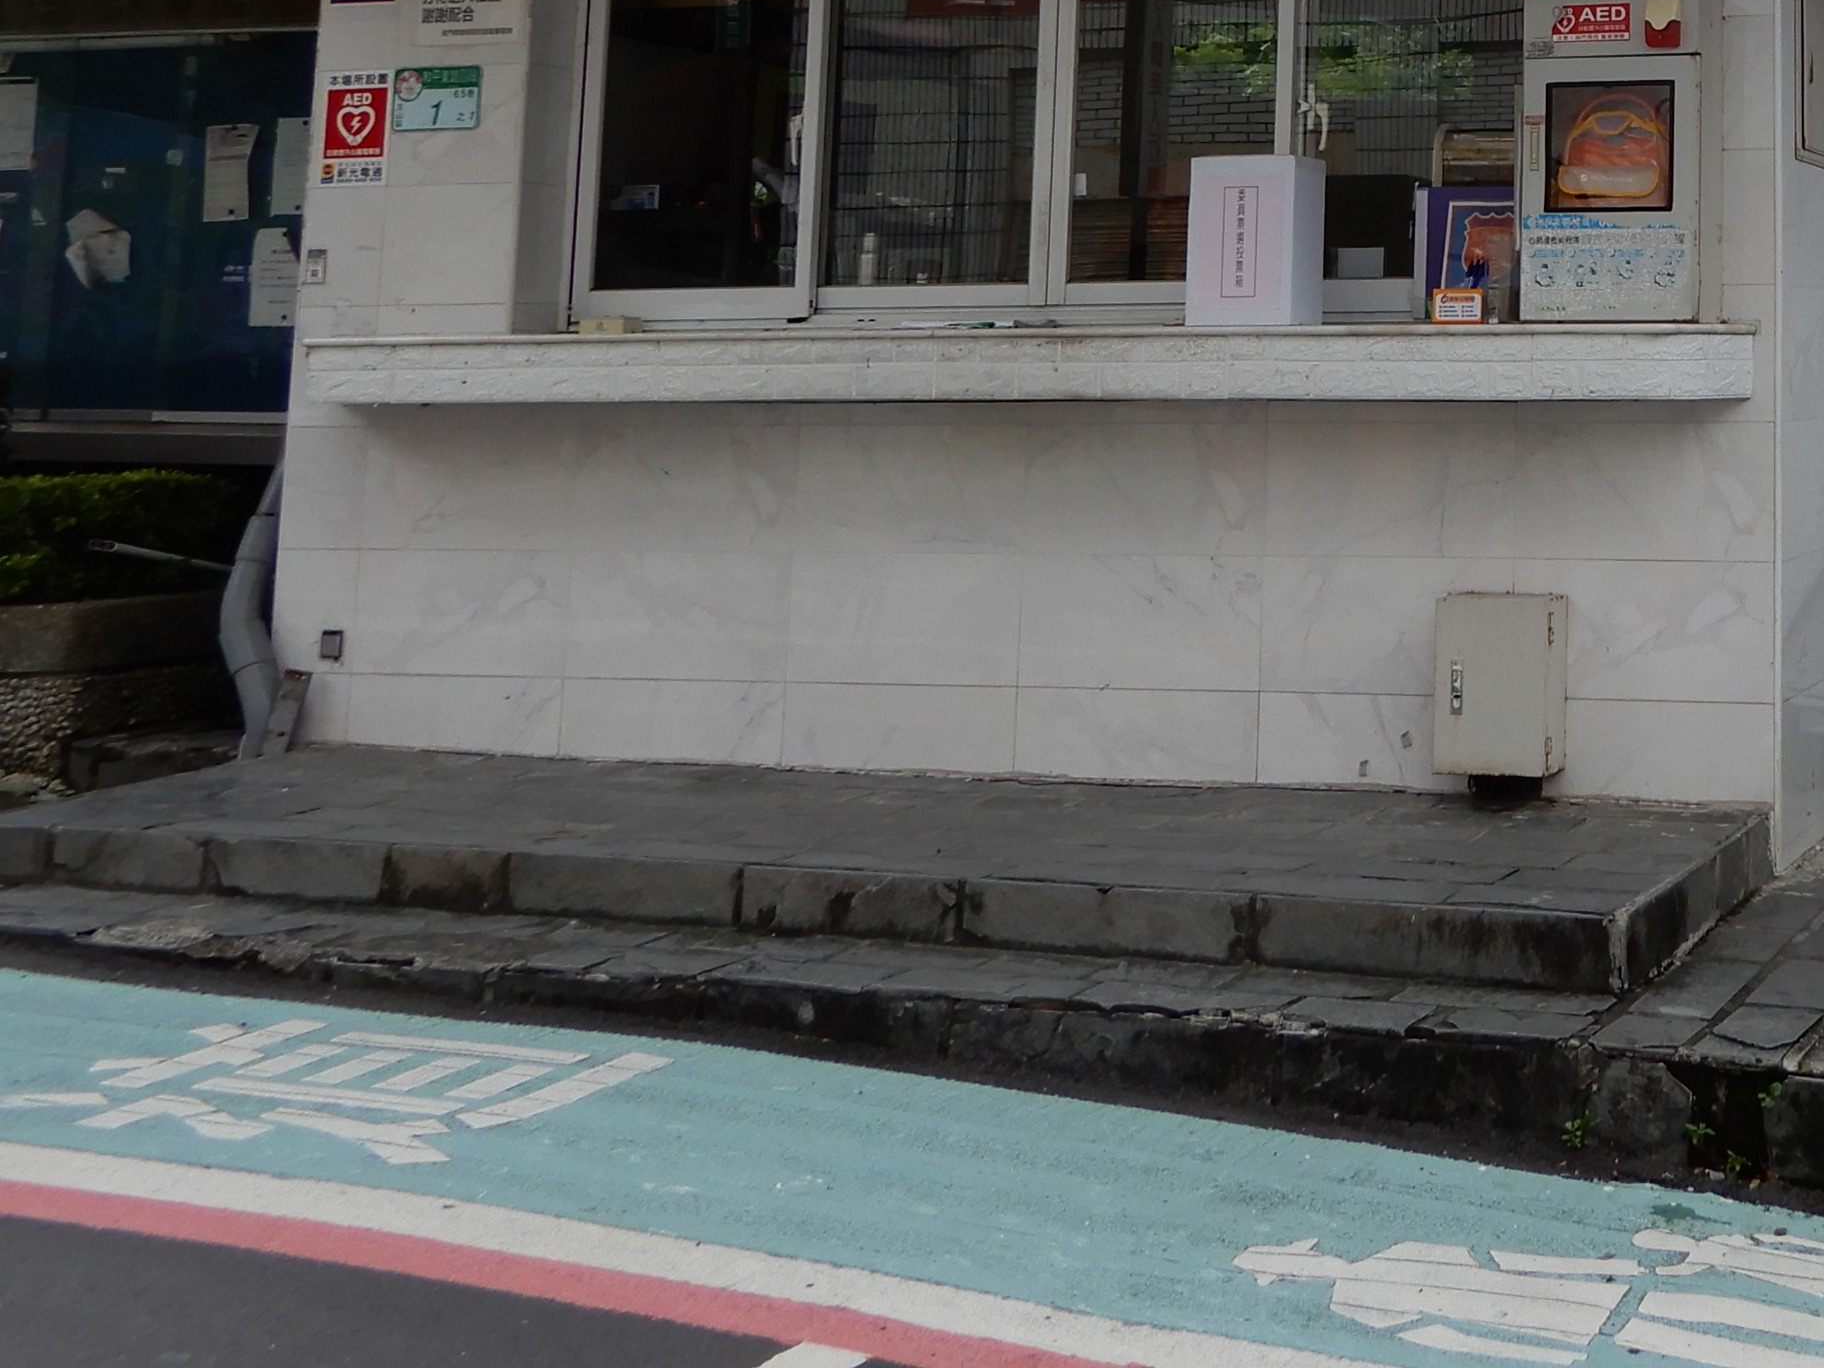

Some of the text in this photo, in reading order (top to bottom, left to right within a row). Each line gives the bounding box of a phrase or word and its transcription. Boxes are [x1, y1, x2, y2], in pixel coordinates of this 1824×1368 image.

[421, 6, 475, 24] 謝謝配合
[1579, 6, 1626, 22] AED
[329, 73, 389, 86] 本場所設置
[342, 92, 373, 107] AED
[430, 100, 443, 126] 1
